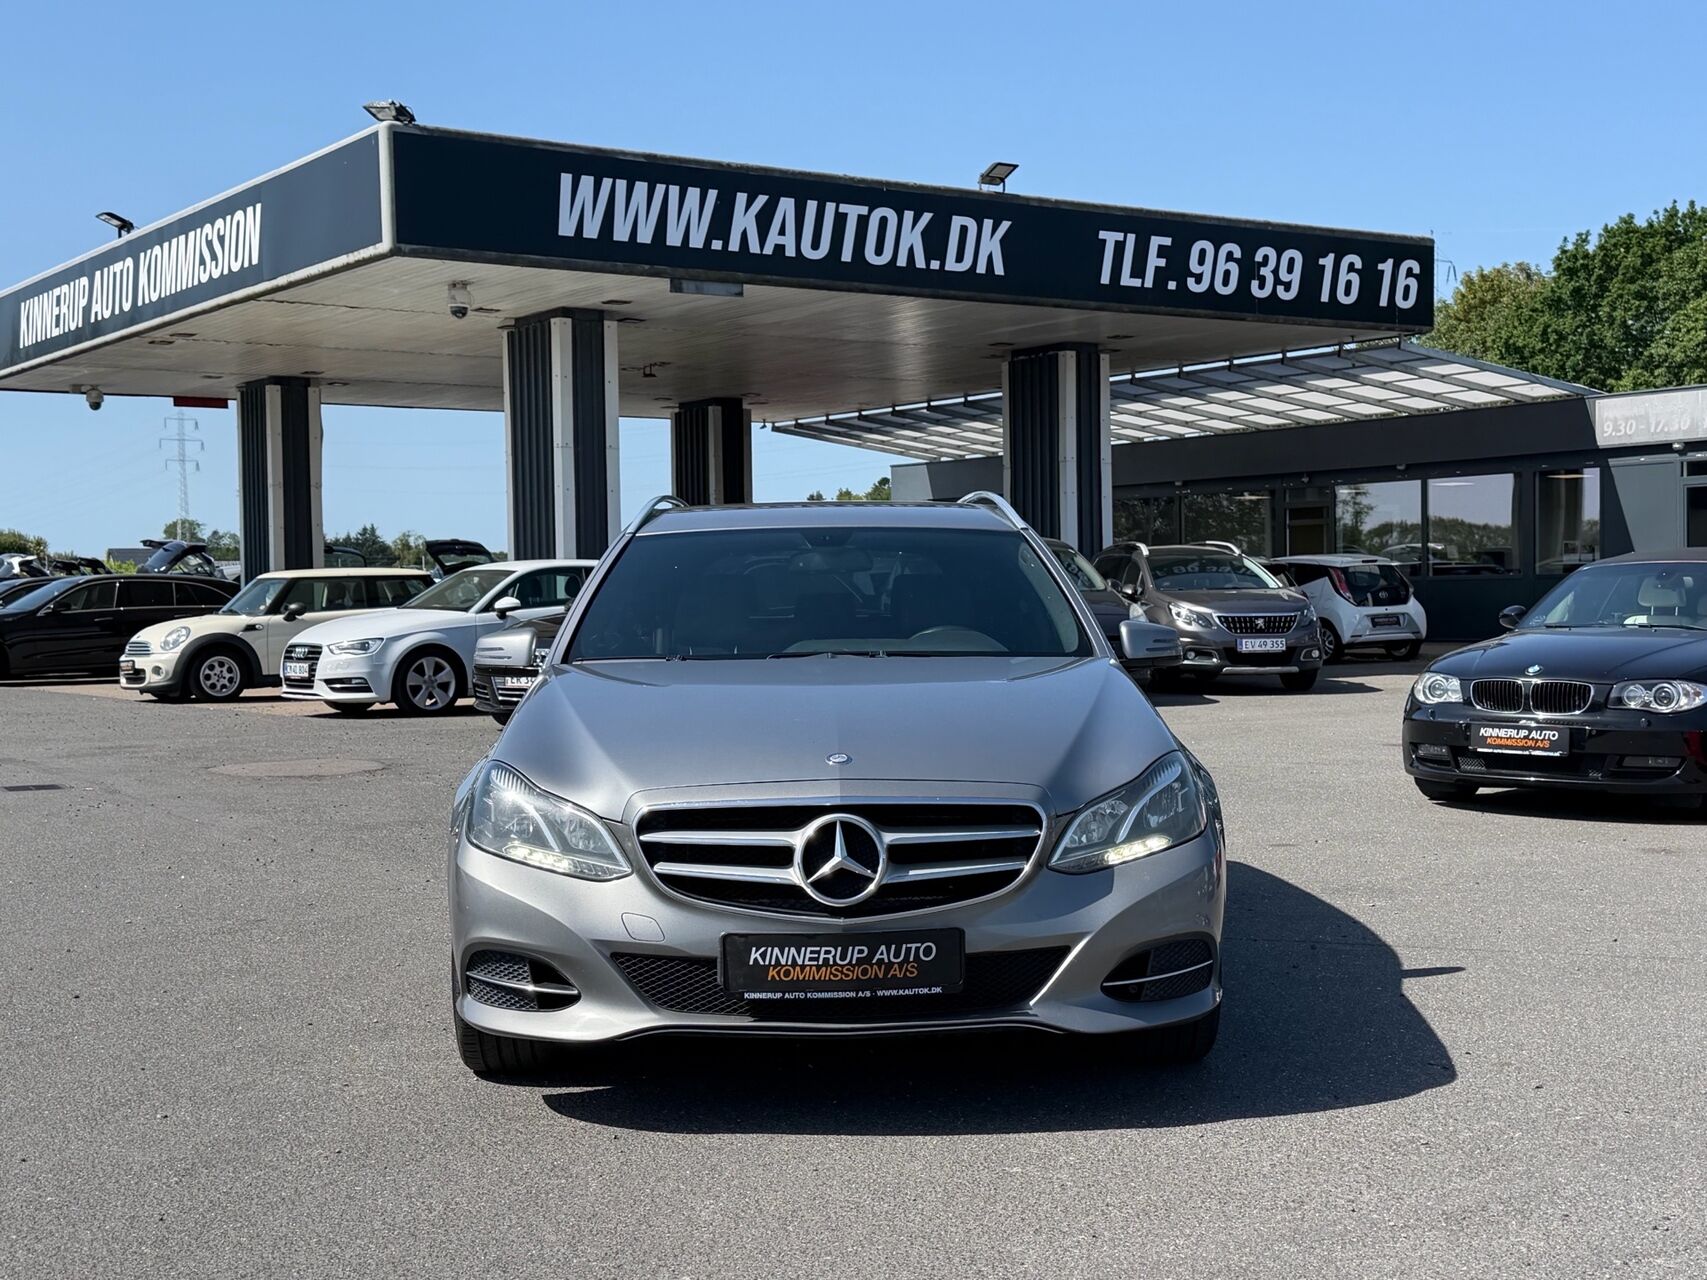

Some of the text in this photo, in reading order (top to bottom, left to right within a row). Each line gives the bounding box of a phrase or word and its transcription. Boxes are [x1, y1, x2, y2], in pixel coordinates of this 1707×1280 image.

[558, 172, 1011, 276] WWW.KAUTOK.DK
[19, 203, 262, 349] KINNERUP AUTO KOMMISSION
[1098, 230, 1421, 309] TLF. 96 39 16 16
[1603, 419, 1636, 437] 9.30
[1244, 640, 1285, 649] EV 49 355
[1480, 727, 1559, 740] KINNERUP AUTO
[1486, 737, 1550, 748] KOMMISSION A/S
[749, 942, 937, 966] KINNERUP AUTO
[768, 962, 919, 981] KOMMISSION A/S
[744, 991, 783, 1000] KINNERUP
[784, 991, 805, 999] AUTO
[807, 990, 856, 999] KOMMISSION
[858, 990, 871, 998] A/S
[877, 987, 942, 997] WWW.KAUTOK.DK
